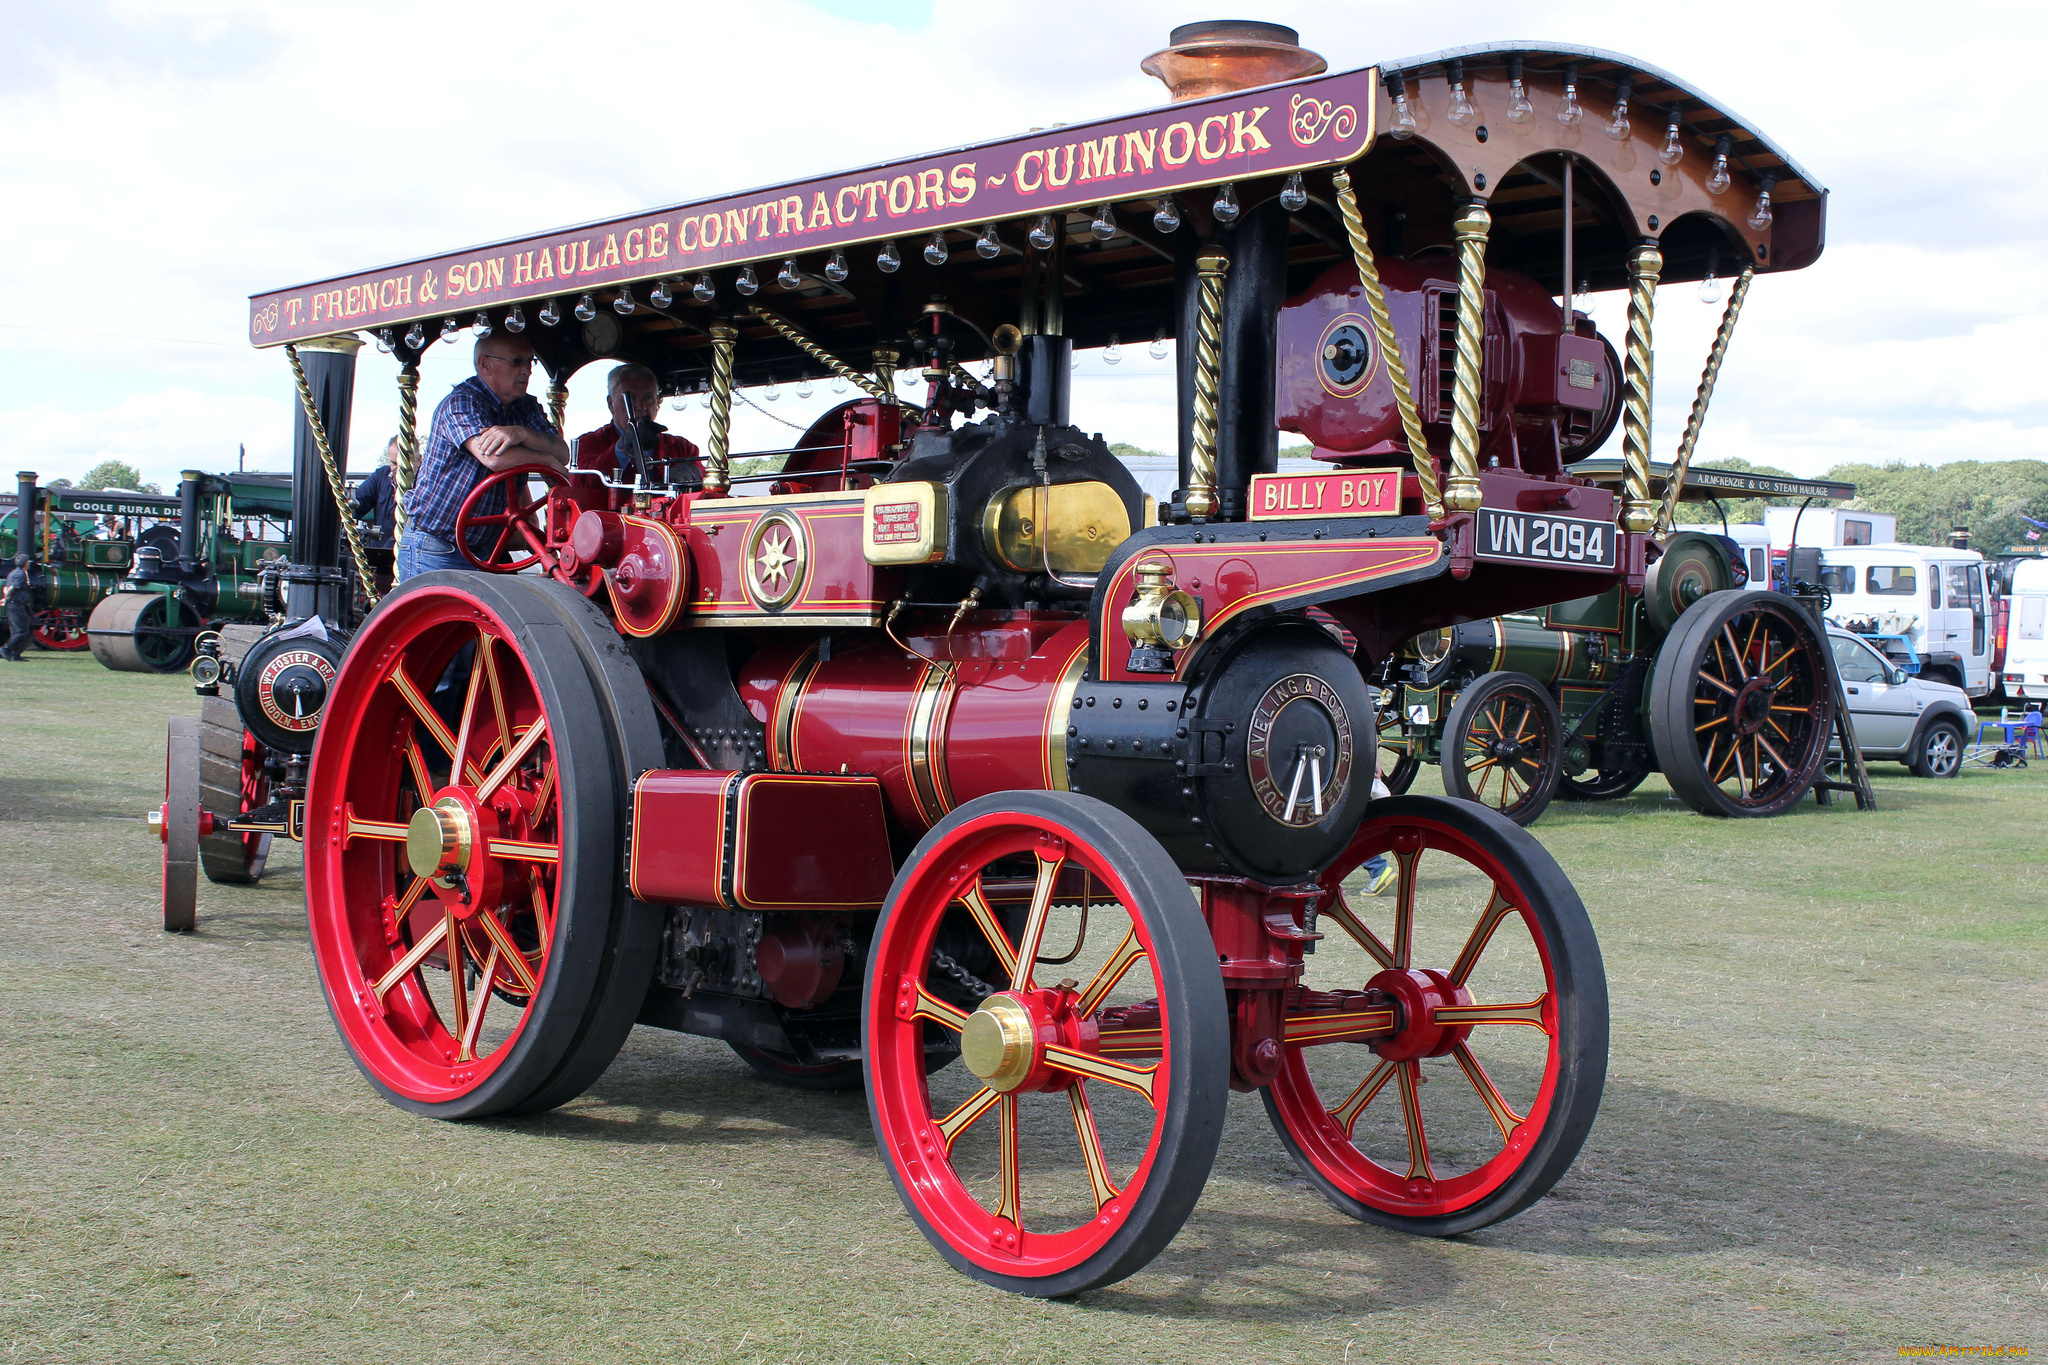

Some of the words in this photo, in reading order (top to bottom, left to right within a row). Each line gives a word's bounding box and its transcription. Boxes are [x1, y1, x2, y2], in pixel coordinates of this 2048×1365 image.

[284, 297, 306, 329] T.
[309, 276, 412, 324] FRENCH
[419, 268, 439, 303] &
[445, 256, 505, 298] SON
[511, 222, 670, 287] HAULAGE
[676, 162, 977, 255] CONTRACTORS
[1011, 106, 1272, 196] CUMNOCK
[73, 502, 114, 512] GOOLE
[118, 504, 159, 515] RURAL
[1264, 481, 1326, 511] BILLY
[1341, 479, 1385, 509] BOY
[1774, 482, 1798, 493] STEAM
[1799, 485, 1828, 497] HAULAGE
[1489, 513, 1525, 554] VN
[1531, 519, 1604, 562] 2094
[271, 653, 309, 672] FOSTER
[311, 657, 320, 667] &
[1250, 679, 1299, 758] AVELING
[1303, 677, 1313, 694] &
[1318, 684, 1351, 763] PORTER
[1254, 776, 1344, 825] ROCESER
